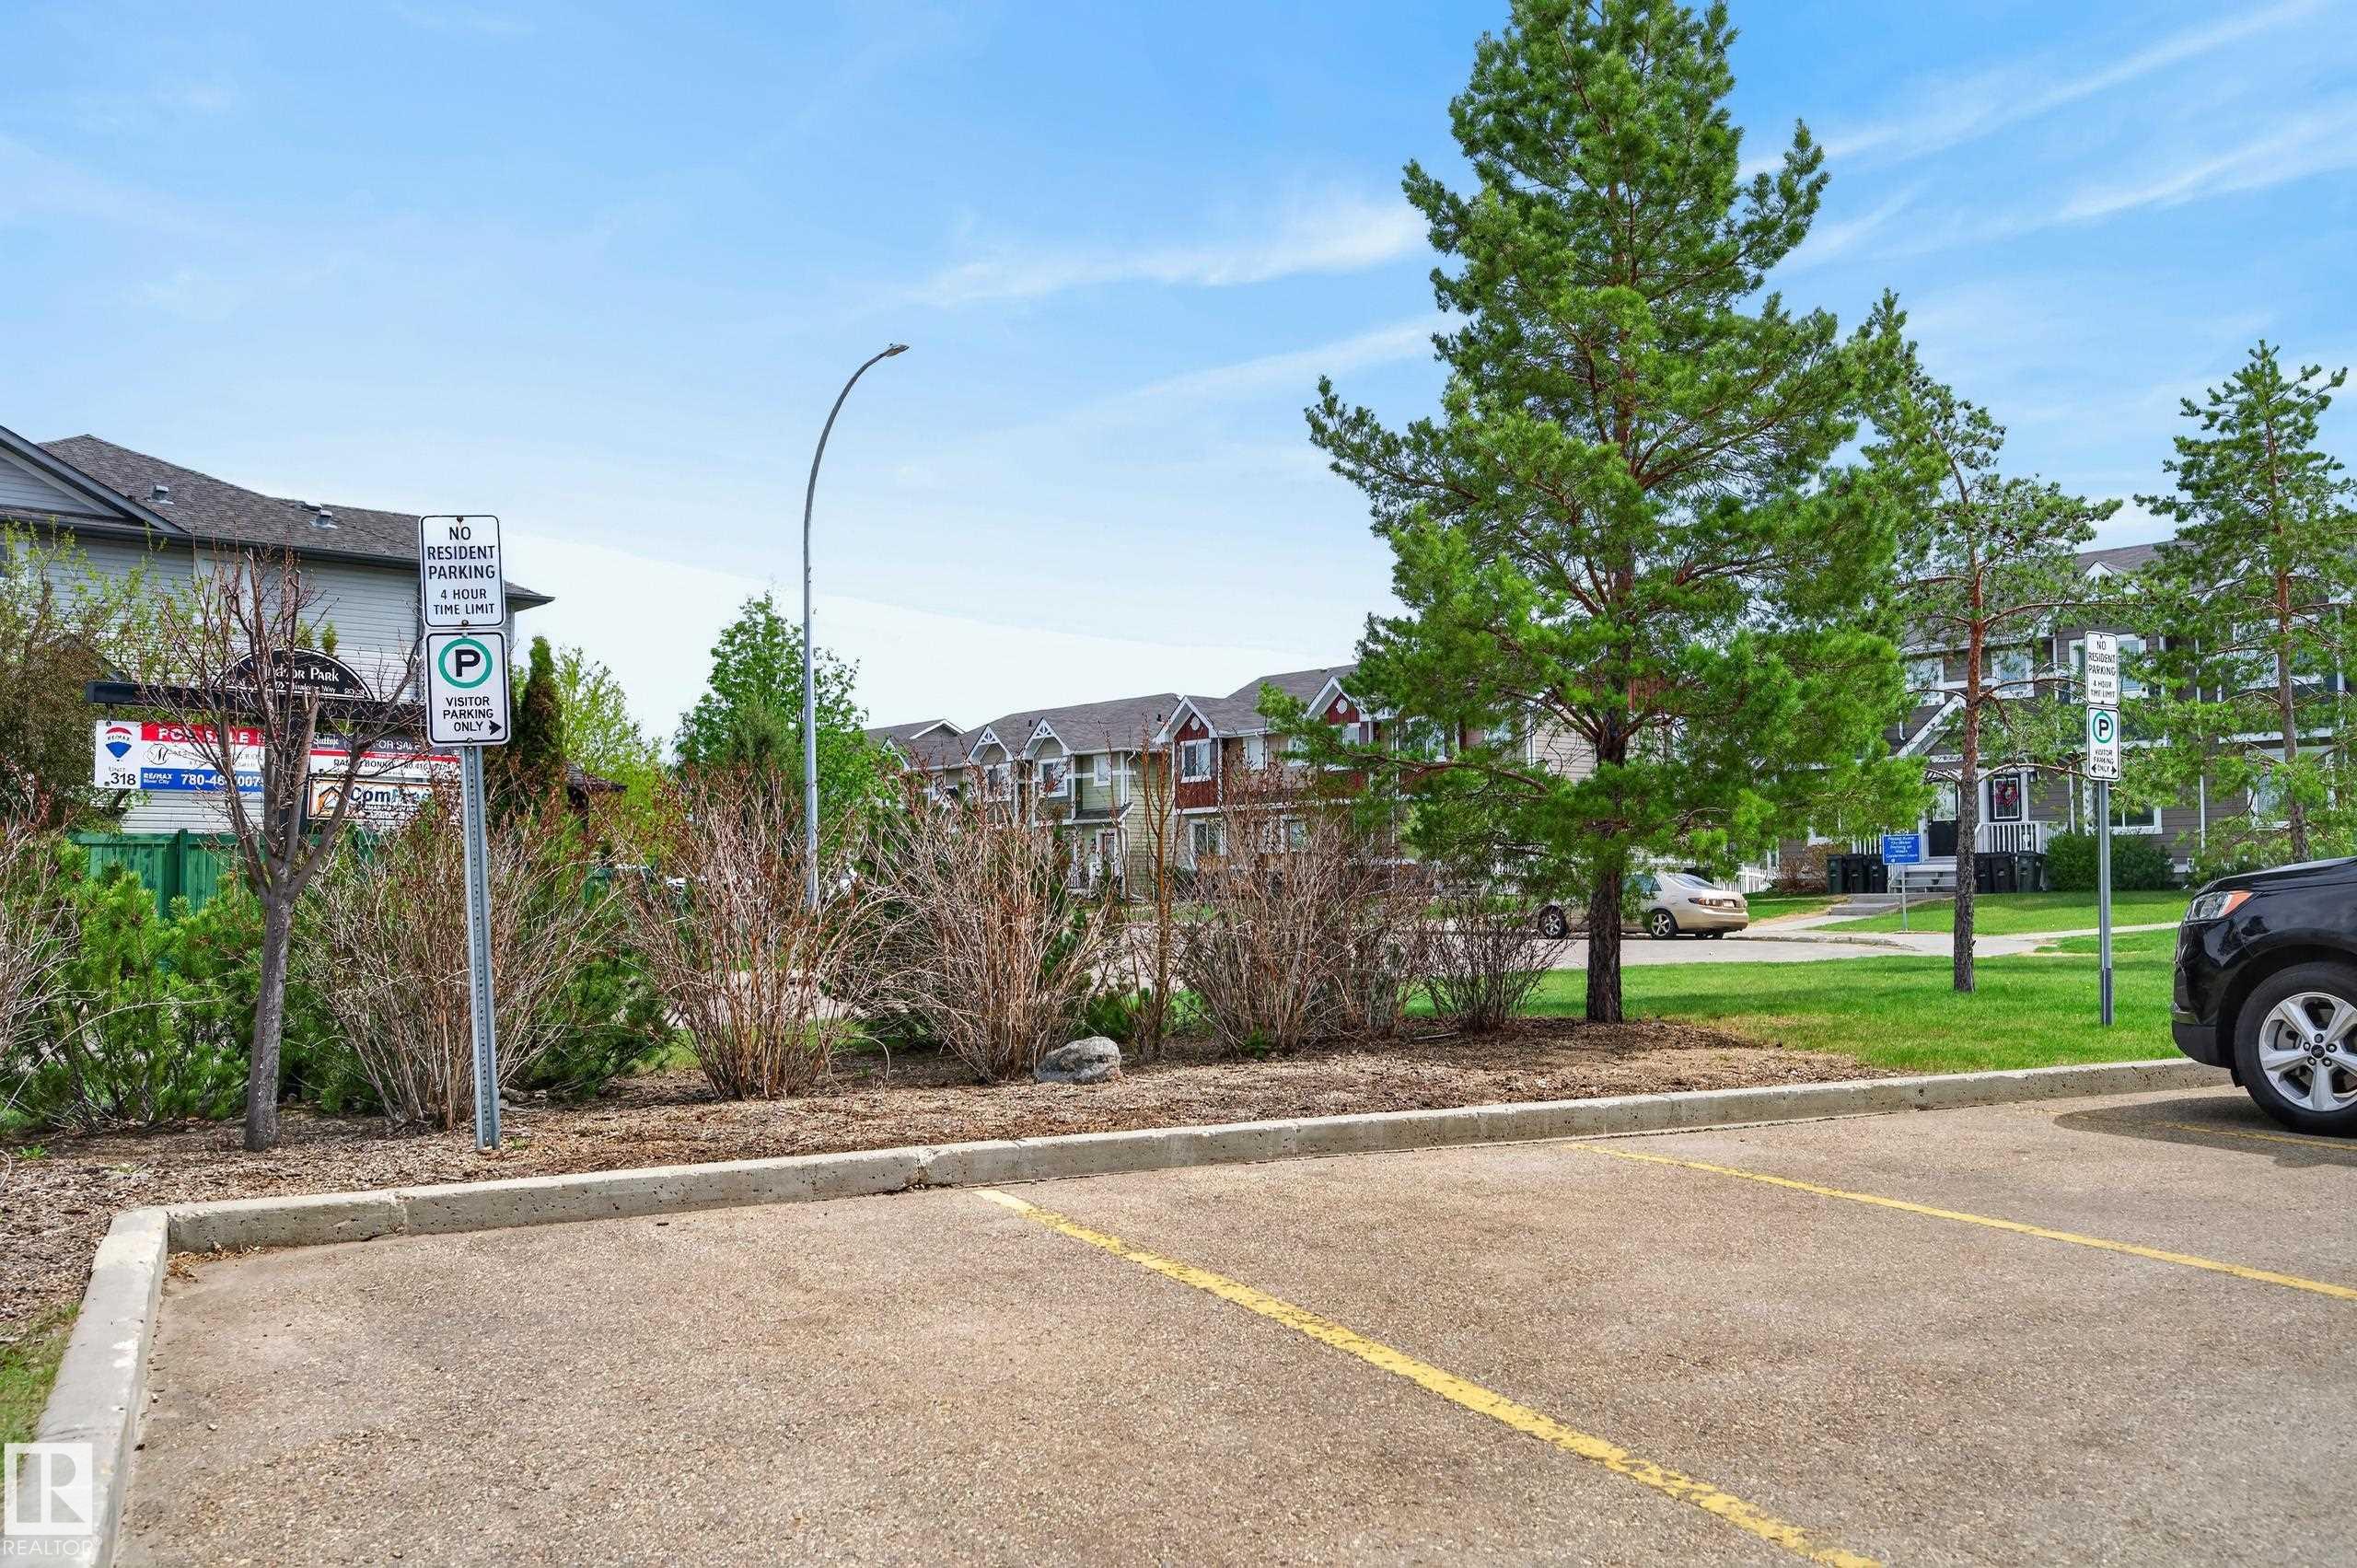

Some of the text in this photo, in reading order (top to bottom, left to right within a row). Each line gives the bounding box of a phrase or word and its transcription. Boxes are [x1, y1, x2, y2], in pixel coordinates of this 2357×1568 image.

[449, 527, 471, 540] NO
[427, 545, 495, 560] RESIDENT
[428, 564, 495, 580] PARKING
[440, 588, 487, 600] 4 HOUR
[434, 603, 495, 615] TIME LIMIT
[2096, 641, 2107, 650] NO
[455, 649, 481, 678] P
[2088, 652, 2116, 664] RESIDENT
[2088, 665, 2116, 676] PARKING
[2097, 679, 2112, 689] HOUR
[446, 696, 490, 707] VISITOR
[443, 708, 493, 719] PARKING
[453, 721, 483, 732] ONLY
[2098, 718, 2109, 737] P
[110, 772, 136, 785] 318
